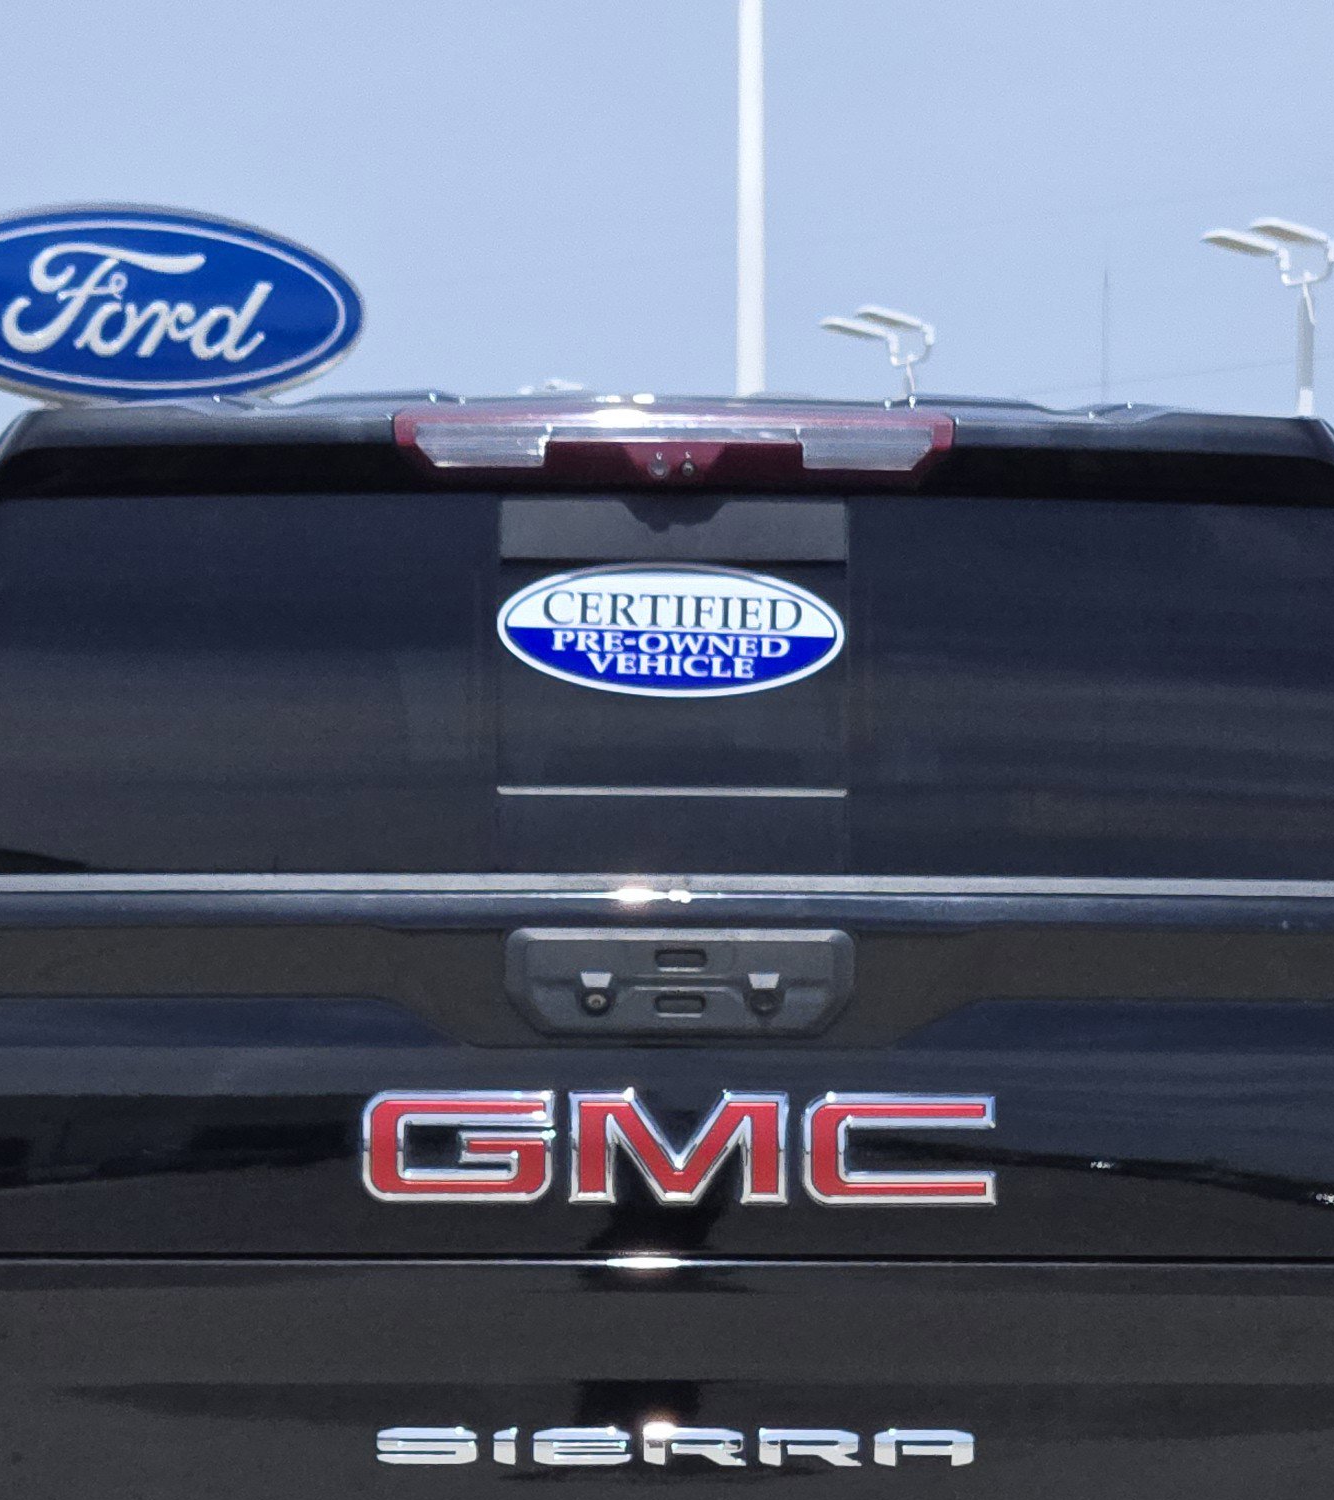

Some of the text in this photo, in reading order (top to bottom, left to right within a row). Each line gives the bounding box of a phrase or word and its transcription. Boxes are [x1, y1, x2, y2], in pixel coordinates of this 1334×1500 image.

[2, 241, 273, 361] Ford
[542, 591, 803, 632] CERTIFIED
[551, 631, 791, 658] PRE-OWNED
[586, 653, 755, 679] VEHICLE
[362, 1088, 996, 1205] GMC
[376, 1426, 975, 1467] SIERRA
